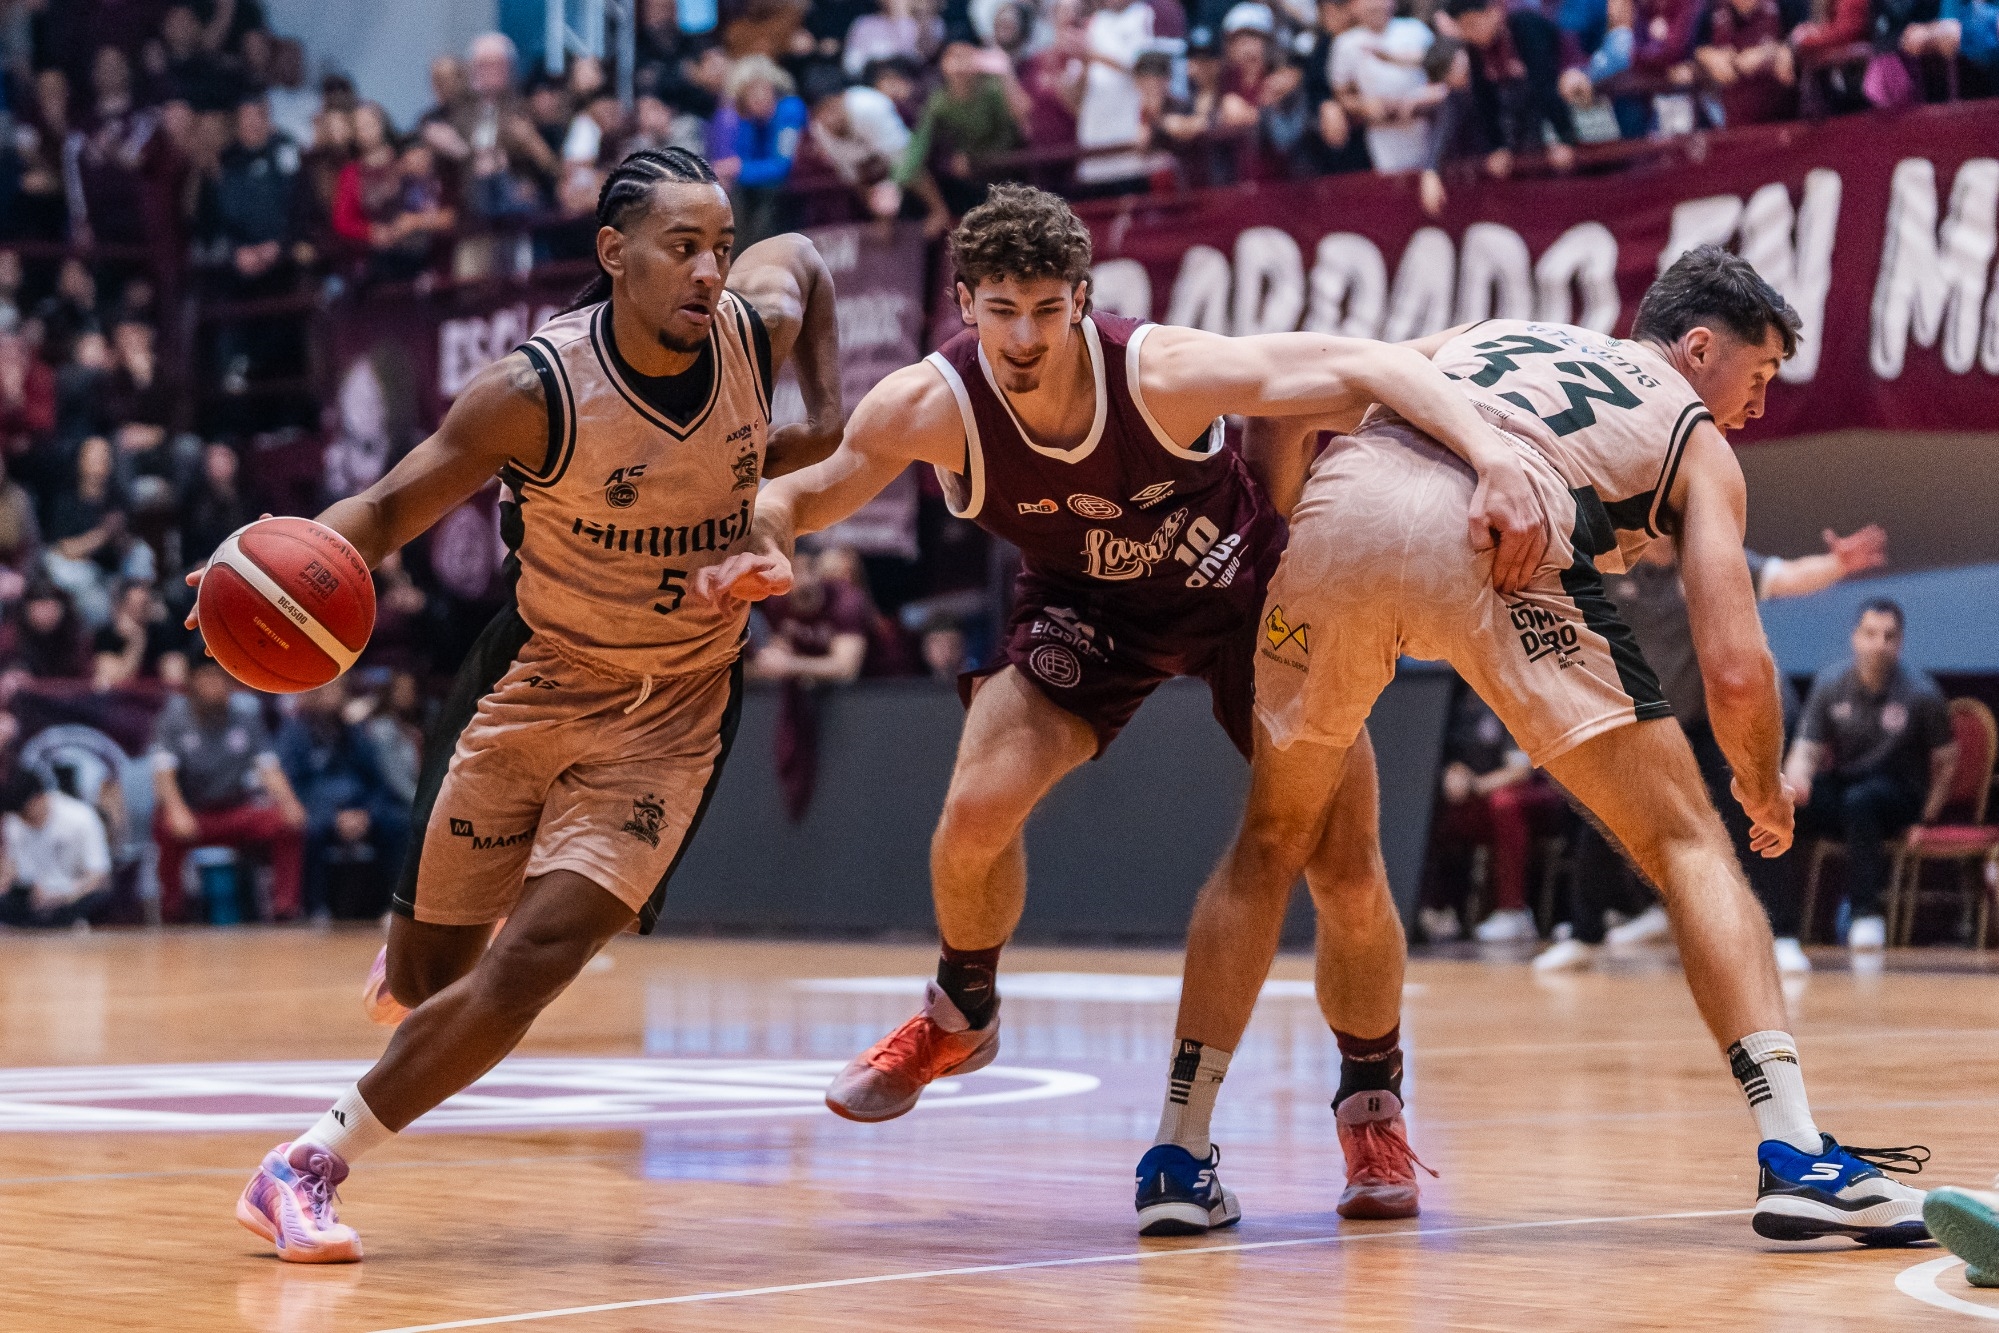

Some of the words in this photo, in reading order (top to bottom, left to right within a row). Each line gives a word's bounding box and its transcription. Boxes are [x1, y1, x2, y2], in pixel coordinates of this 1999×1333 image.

[725, 424, 753, 444] AXION
[1020, 503, 1051, 513] LNB
[1138, 488, 1174, 511] umbro
[571, 499, 754, 557] Gimnasi
[1174, 515, 1221, 568] 10
[307, 526, 368, 583] molten
[303, 558, 340, 593] FIBA
[653, 567, 688, 615] 5
[277, 595, 308, 625] BG4500
